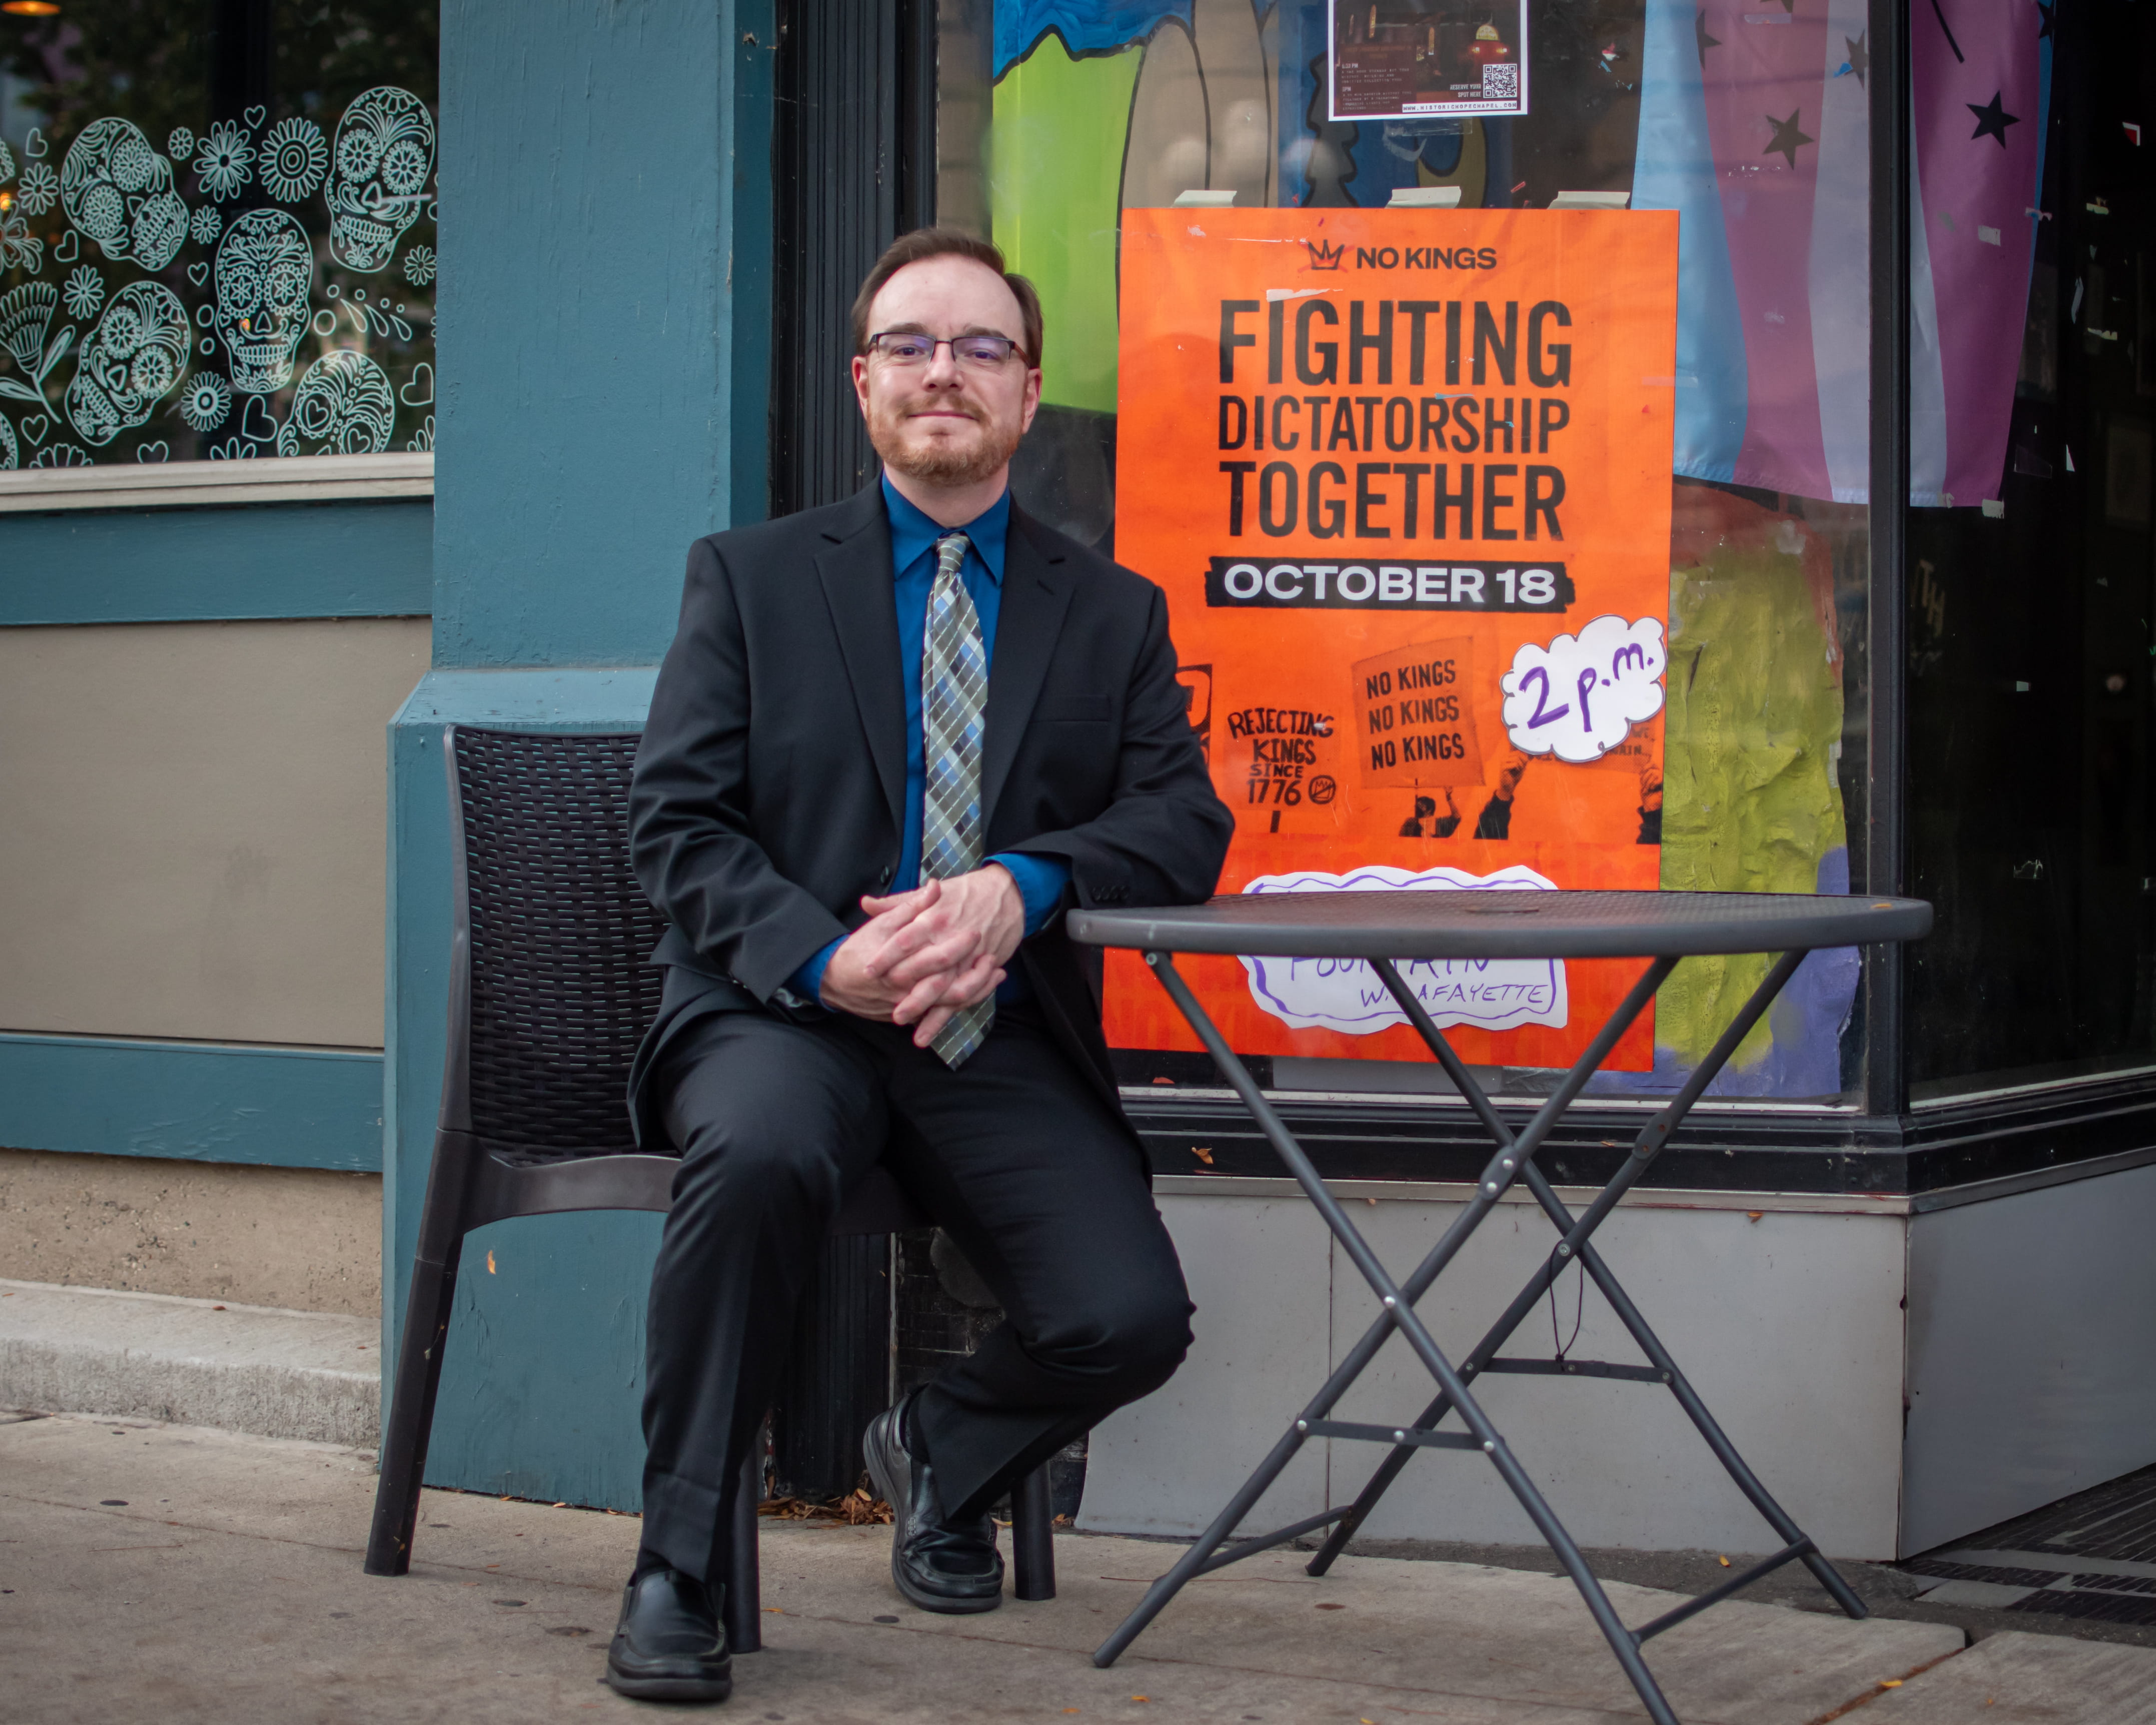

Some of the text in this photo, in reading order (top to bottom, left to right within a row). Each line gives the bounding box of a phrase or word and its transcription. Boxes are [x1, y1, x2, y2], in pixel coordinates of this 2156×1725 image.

[1403, 102, 1517, 111] WWW.HISTORICHOPECHAPEL.COM
[1356, 247, 1497, 270] NO KINGS
[1219, 299, 1572, 388] FIGHTING
[1219, 395, 1571, 454] DICTATORSHIP
[1219, 461, 1566, 541] TOGETHER
[1224, 564, 1556, 604] OCTOBER 18
[1366, 659, 1456, 699] NO KINGS
[1519, 643, 1654, 732] 2 p.m.
[1227, 707, 1335, 739] REJECTING
[1369, 695, 1460, 735] NO KINGS
[1249, 763, 1304, 778] SINCE
[1253, 737, 1317, 765] KINGS
[1371, 732, 1465, 771] NO KINGS
[1247, 778, 1302, 806] 1776
[1416, 982, 1549, 1004] AFAYETTE
